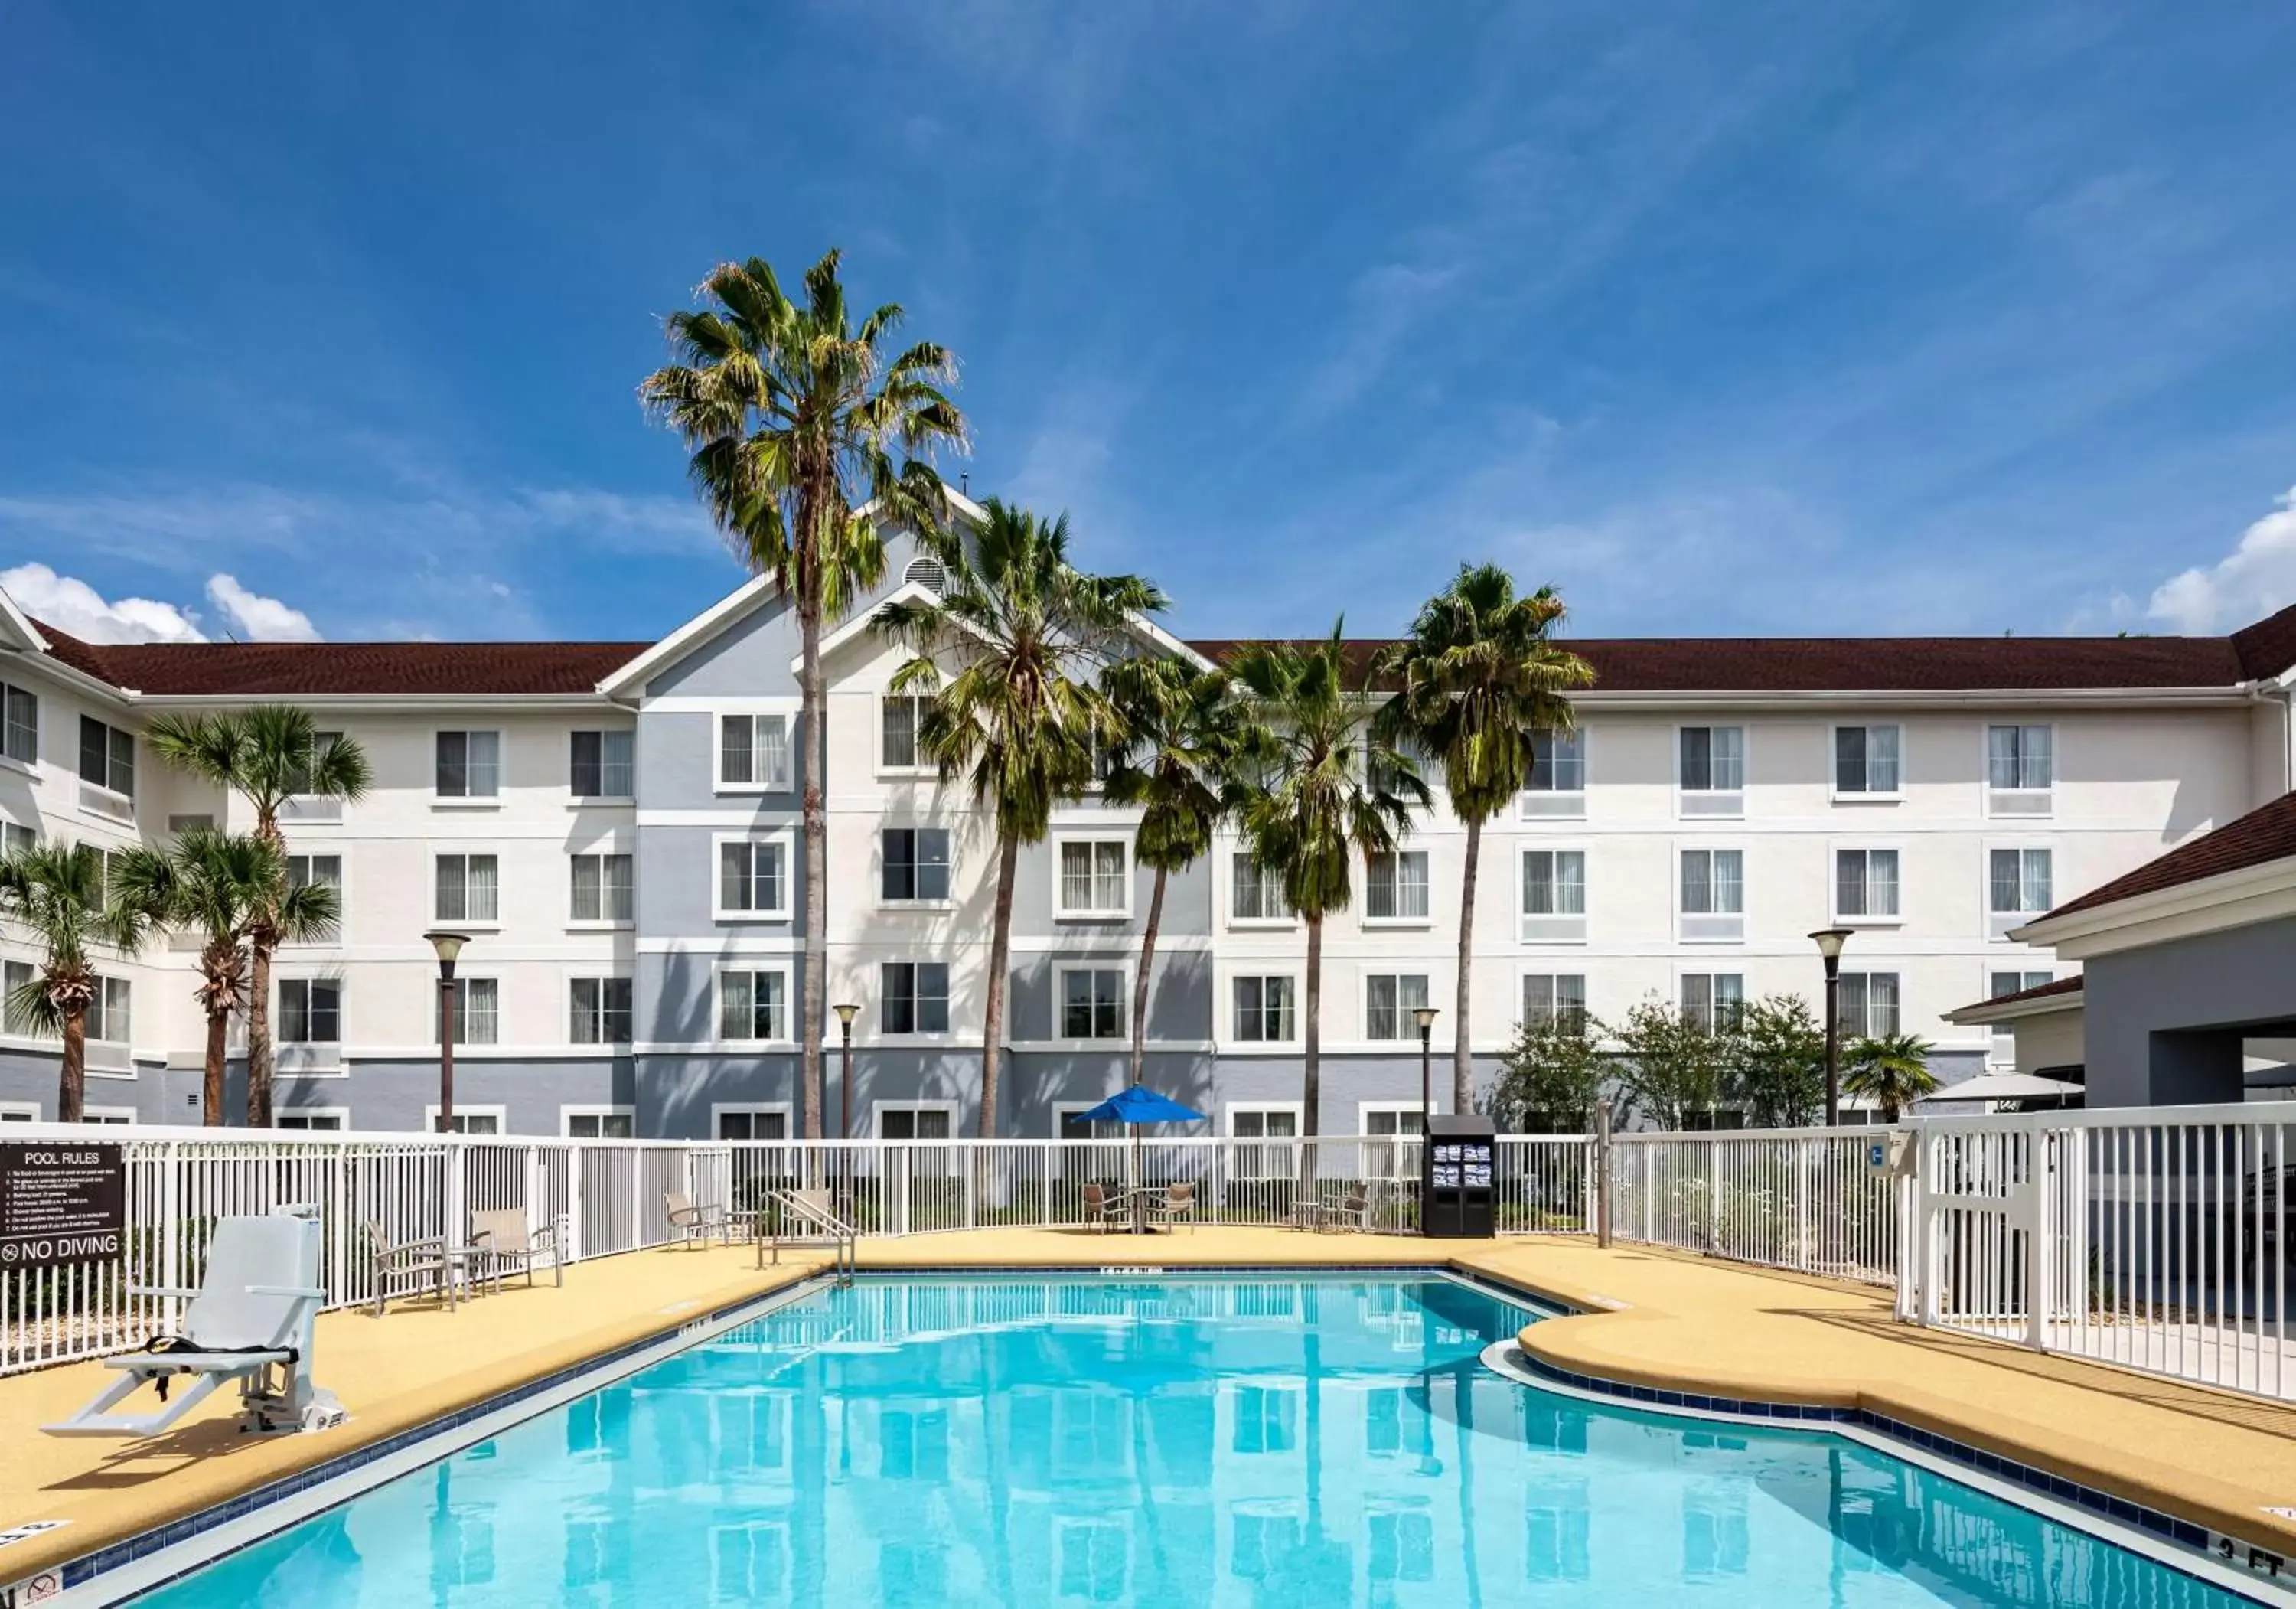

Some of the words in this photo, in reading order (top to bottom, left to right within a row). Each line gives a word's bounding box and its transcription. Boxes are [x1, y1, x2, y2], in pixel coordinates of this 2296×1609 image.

[24, 1152, 59, 1164] POOL
[62, 1152, 100, 1164] RULES
[21, 1241, 52, 1261] NO
[57, 1235, 118, 1257] DIVING
[2219, 1538, 2235, 1559] 3
[2249, 1547, 2284, 1577] FT
